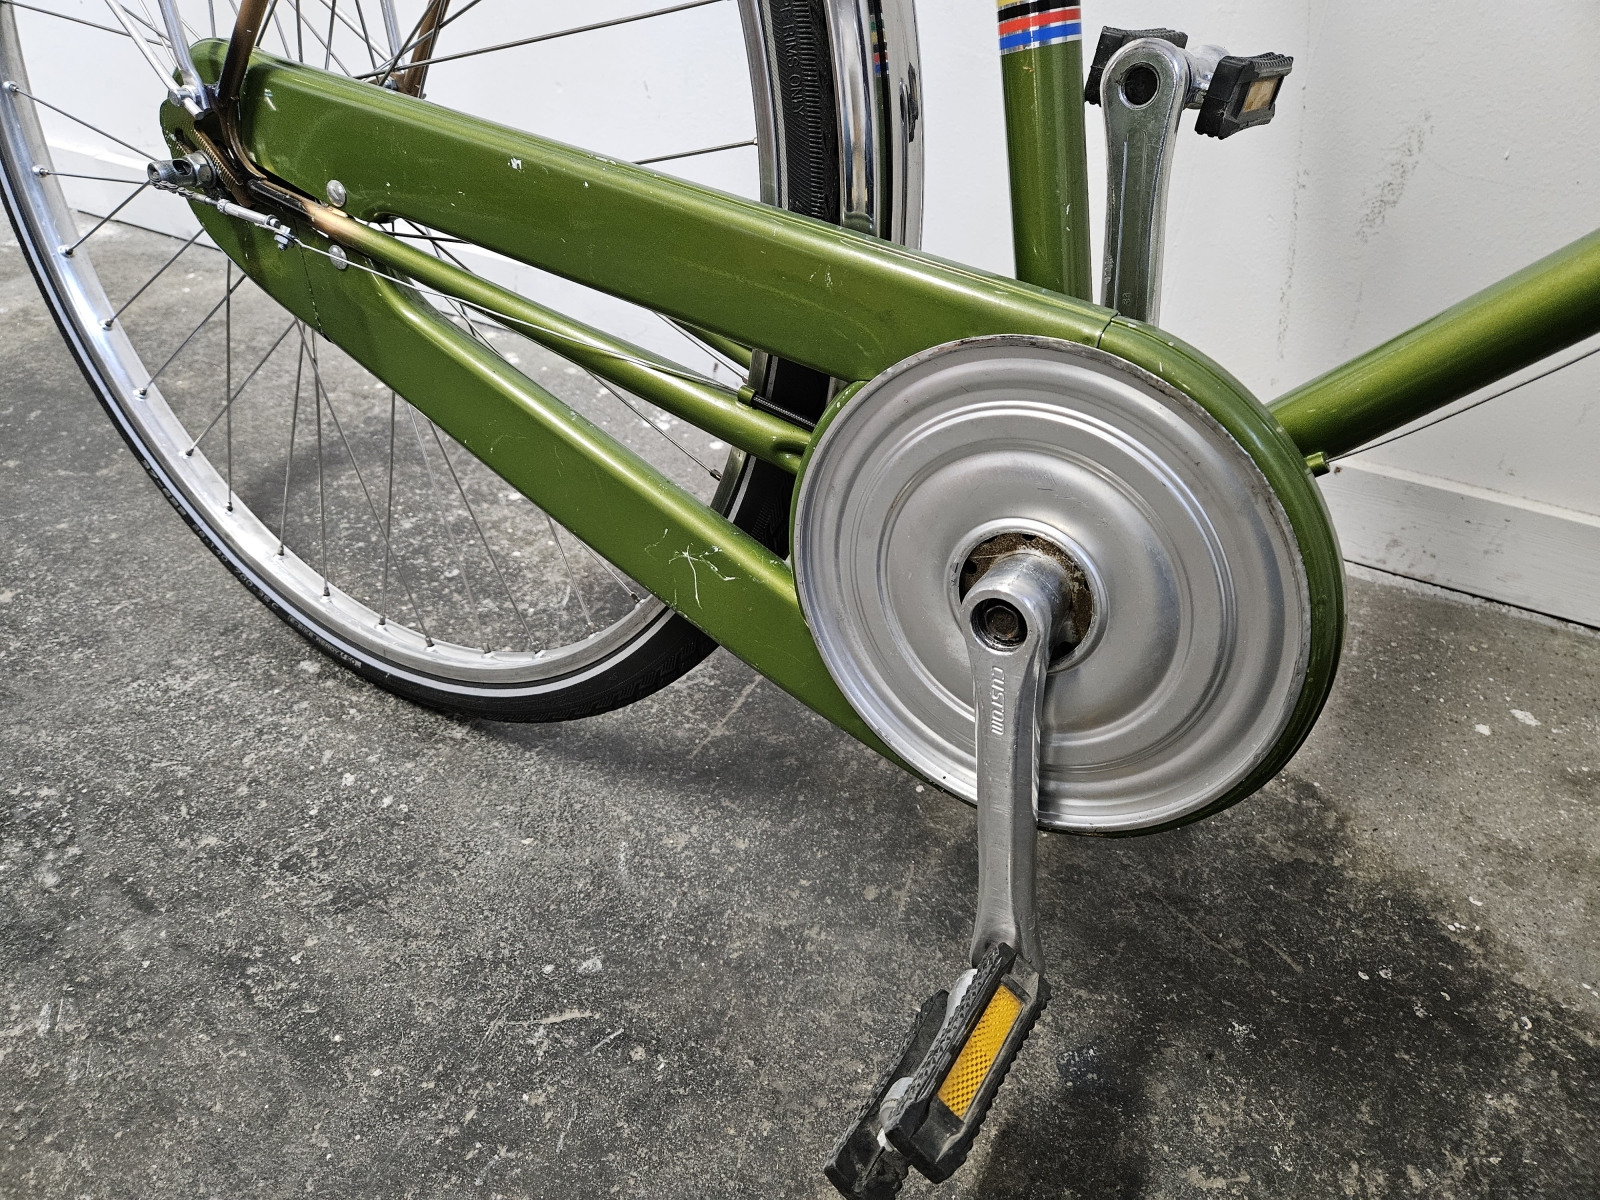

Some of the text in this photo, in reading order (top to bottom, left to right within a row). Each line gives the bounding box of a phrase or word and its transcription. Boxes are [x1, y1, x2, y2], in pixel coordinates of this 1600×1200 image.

[782, 23, 800, 67] RIMS
[788, 74, 805, 116] ONLY
[990, 665, 1005, 736] CUSTOM
